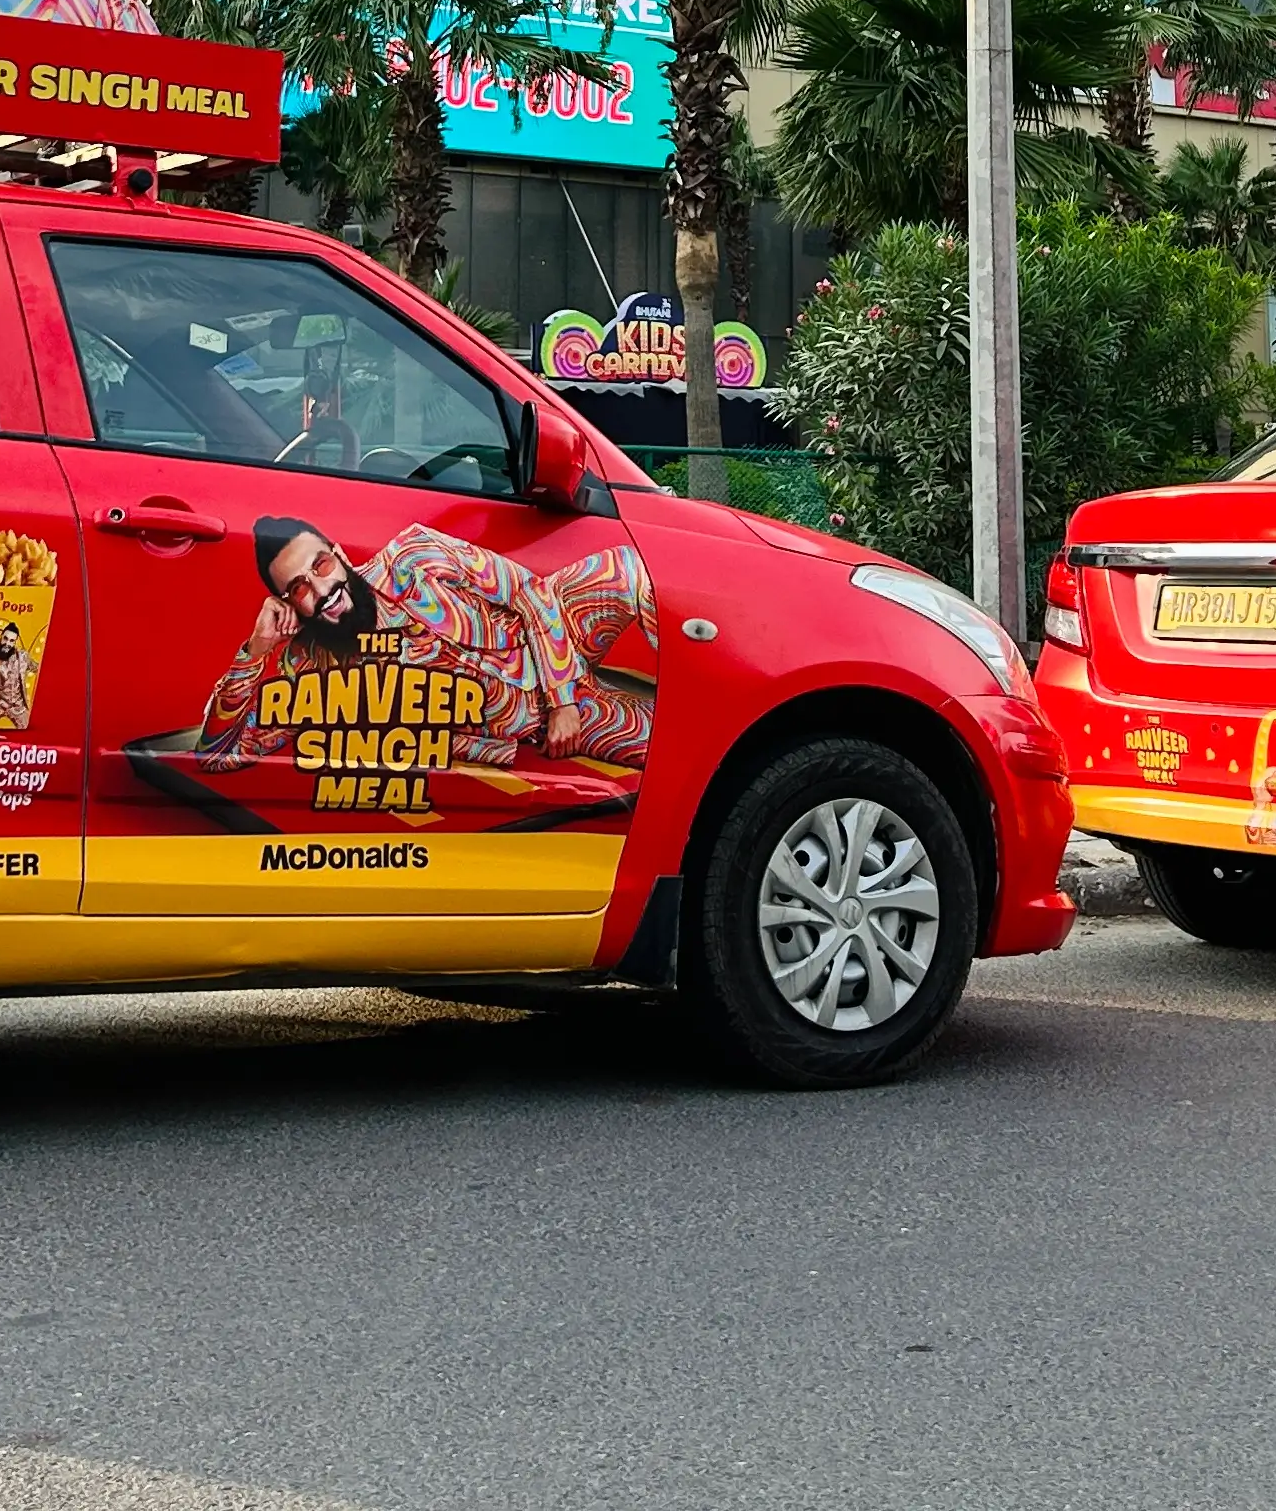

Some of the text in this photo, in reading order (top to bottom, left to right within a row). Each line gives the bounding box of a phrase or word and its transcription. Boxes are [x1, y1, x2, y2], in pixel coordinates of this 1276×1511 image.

[29, 63, 159, 114] SINGH
[165, 83, 251, 119] MEAL
[616, 320, 687, 355] KIDS
[586, 351, 688, 381] CARNIV
[1, 600, 34, 614] Pops
[356, 632, 400, 653] THE
[258, 663, 486, 727] RANVEER
[295, 726, 451, 772] SINGH
[1125, 727, 1189, 754] RANVEER
[1137, 750, 1180, 770] SINGH
[1142, 768, 1178, 786] MEAL
[314, 776, 431, 811] MEAL
[259, 842, 430, 871] McDonald's
